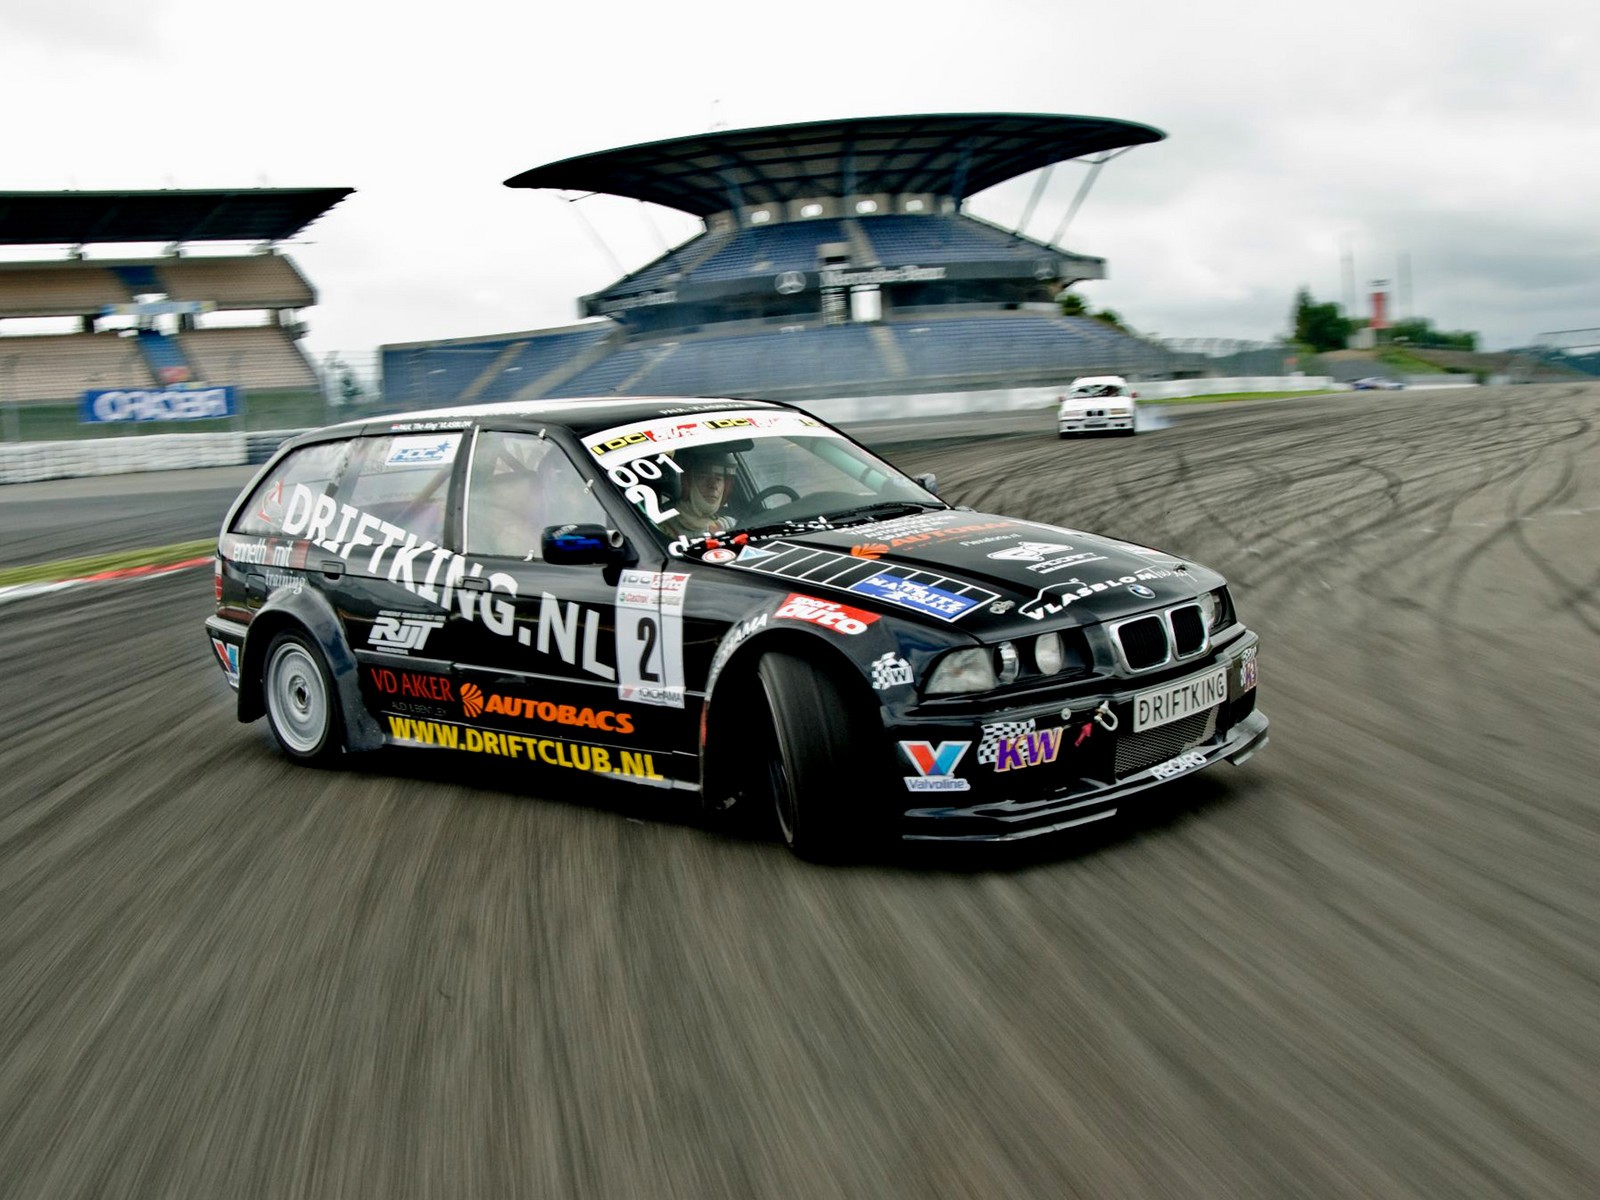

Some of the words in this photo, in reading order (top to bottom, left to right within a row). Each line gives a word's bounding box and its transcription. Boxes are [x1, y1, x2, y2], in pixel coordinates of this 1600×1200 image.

[608, 452, 684, 487] 001
[625, 484, 680, 524] 2
[281, 483, 615, 681] DRIFTKING.NL
[1027, 572, 1158, 620] VLASBLOM
[774, 604, 868, 635] auto
[637, 617, 660, 683] 2
[370, 668, 398, 694] VD
[401, 672, 455, 702] AKKER
[1139, 673, 1225, 726] DRIFTKING
[485, 694, 635, 734] AUTOBACS
[388, 716, 664, 781] WWW.DRIFTCLUB.NL
[994, 727, 1064, 773] KW
[1150, 752, 1208, 781] RECARO
[908, 779, 966, 790] Valvoline
